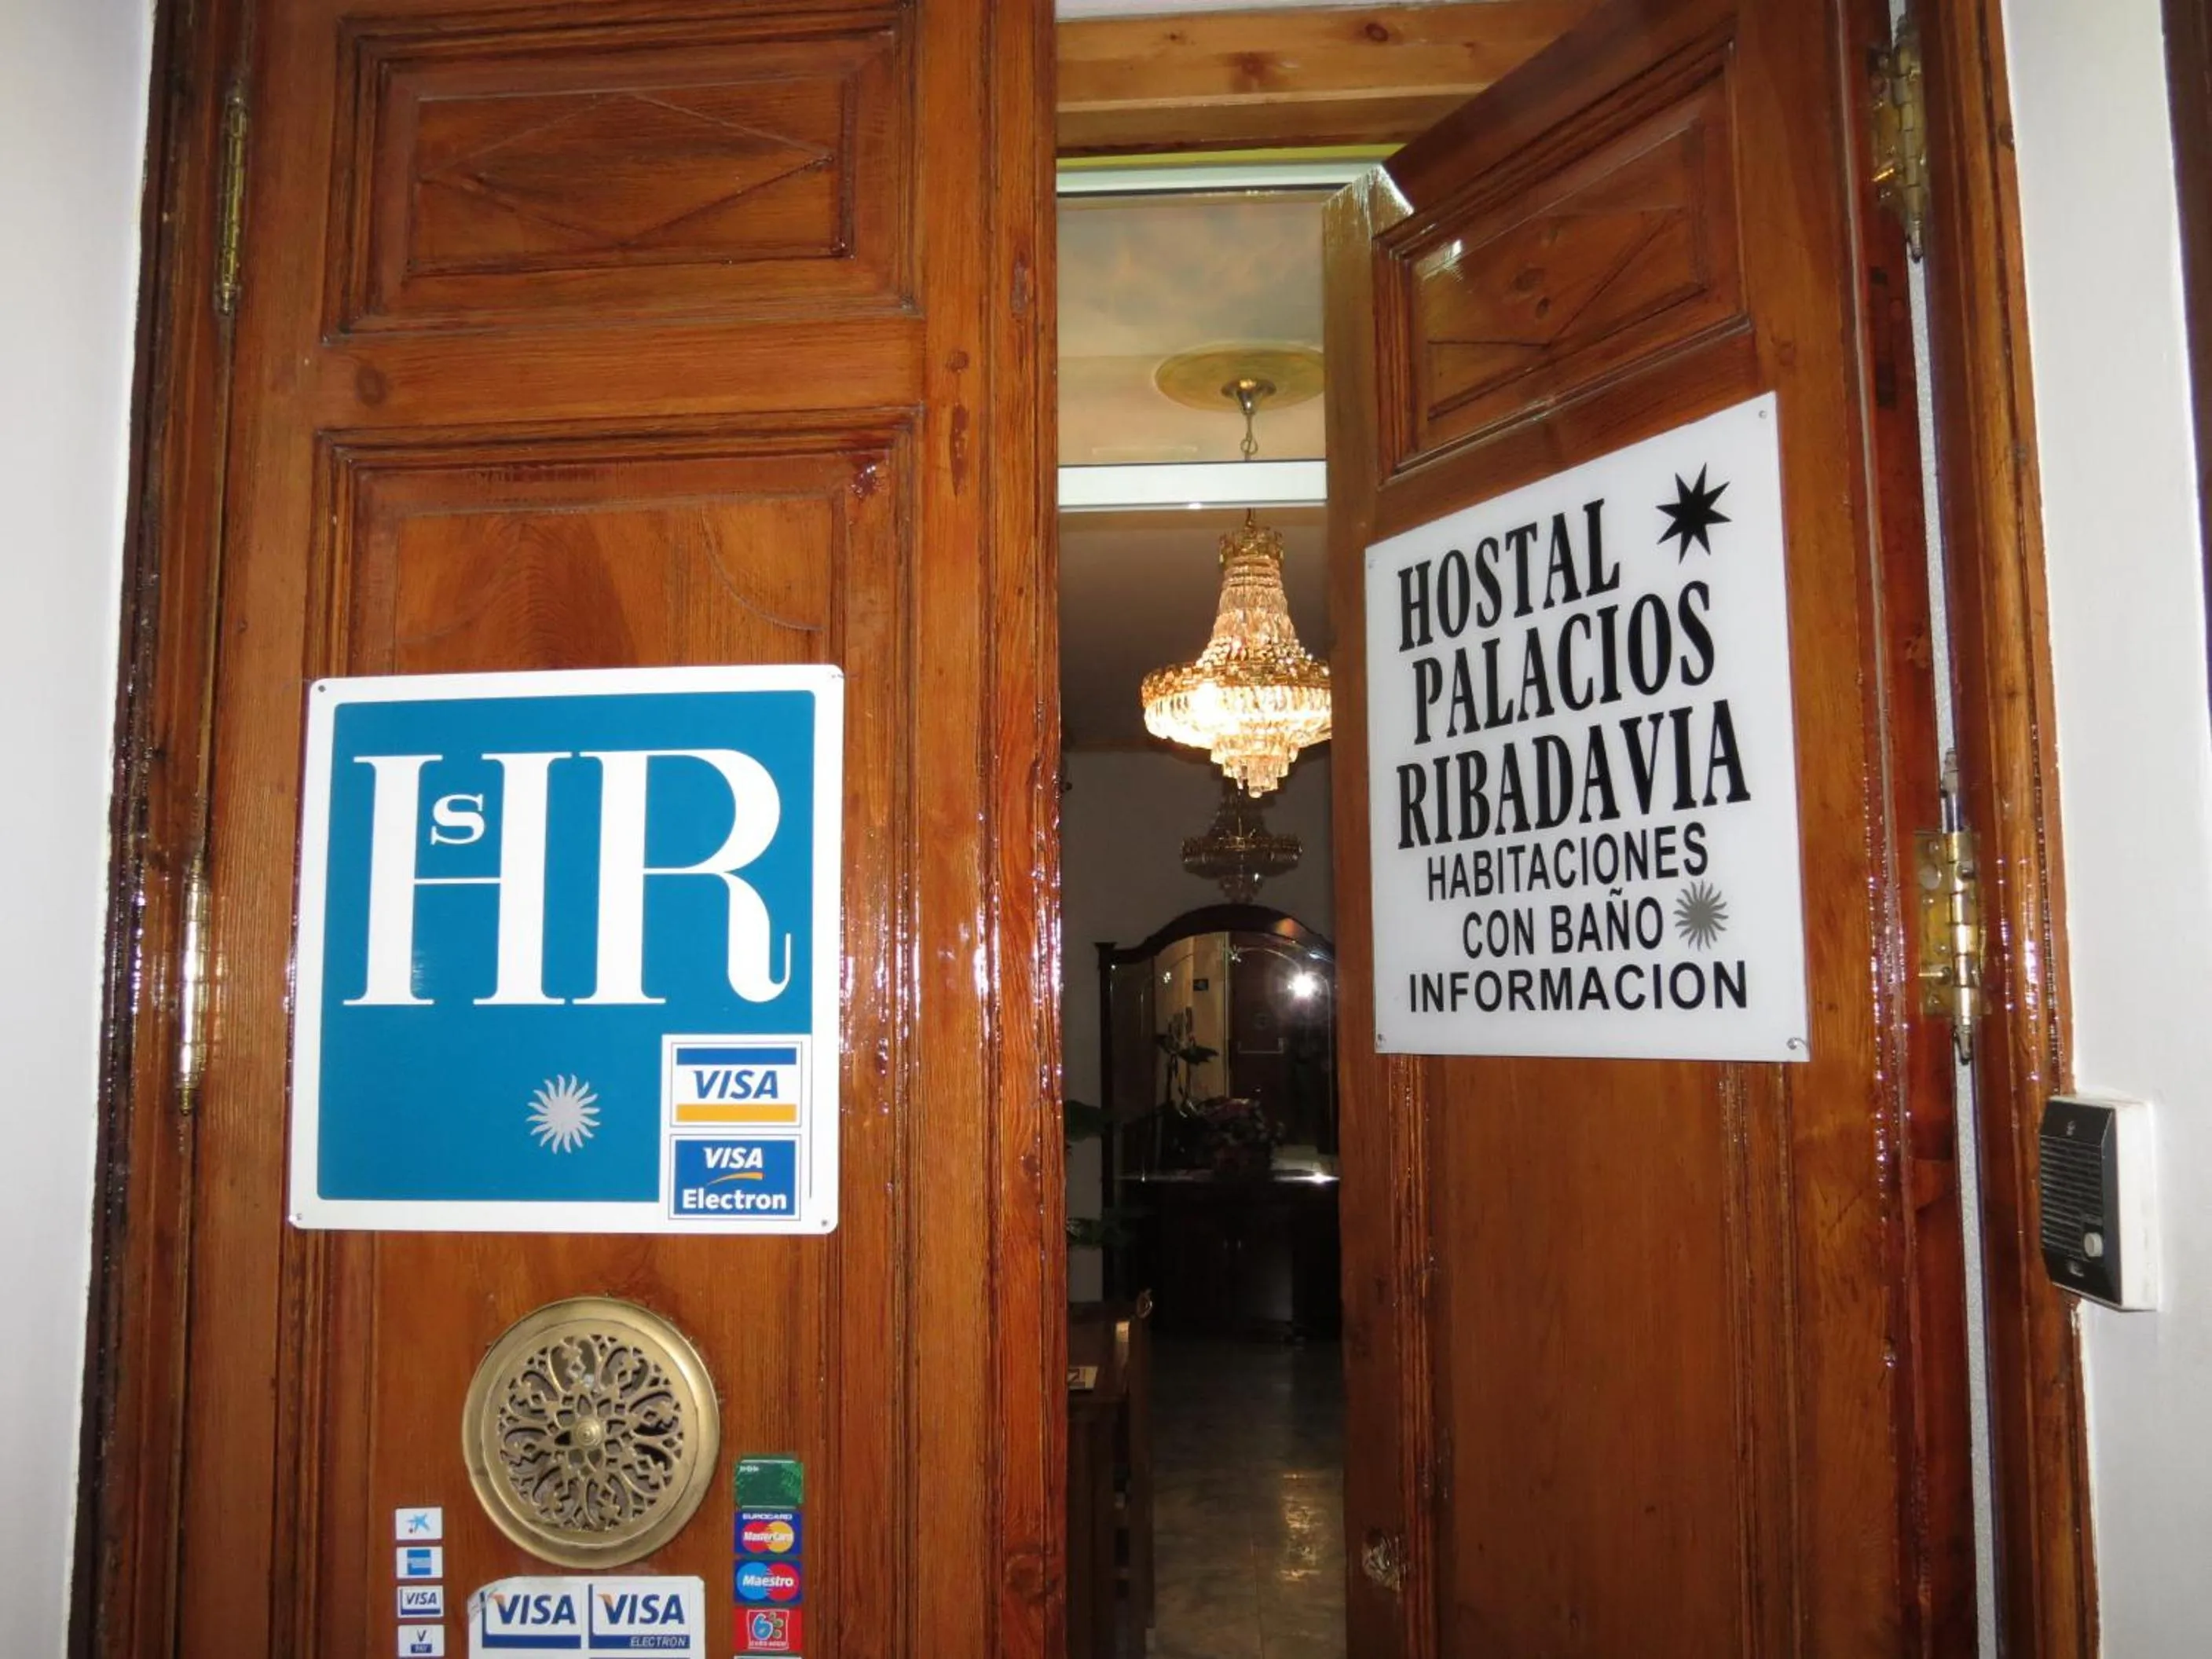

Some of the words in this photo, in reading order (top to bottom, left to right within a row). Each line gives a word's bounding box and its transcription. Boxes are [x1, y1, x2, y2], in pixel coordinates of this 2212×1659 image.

[1398, 498, 1621, 653] HOSTAL
[1412, 580, 1716, 745] PALACIOS
[1396, 698, 1752, 850] RIBADAVIA
[1427, 822, 1709, 902] HABITACIONES
[1462, 908, 1535, 959] CON
[1551, 888, 1664, 954] BAÑO
[1409, 960, 1749, 1013] INFORMACION
[692, 1069, 779, 1100] VISA
[703, 1146, 764, 1169] VISA
[682, 1187, 787, 1210] Electron
[742, 1575, 795, 1587] Maestro
[405, 1591, 438, 1606] VISA
[493, 1594, 577, 1625] VISA
[596, 1594, 686, 1625] VISA
[630, 1635, 687, 1647] ELECTRON
